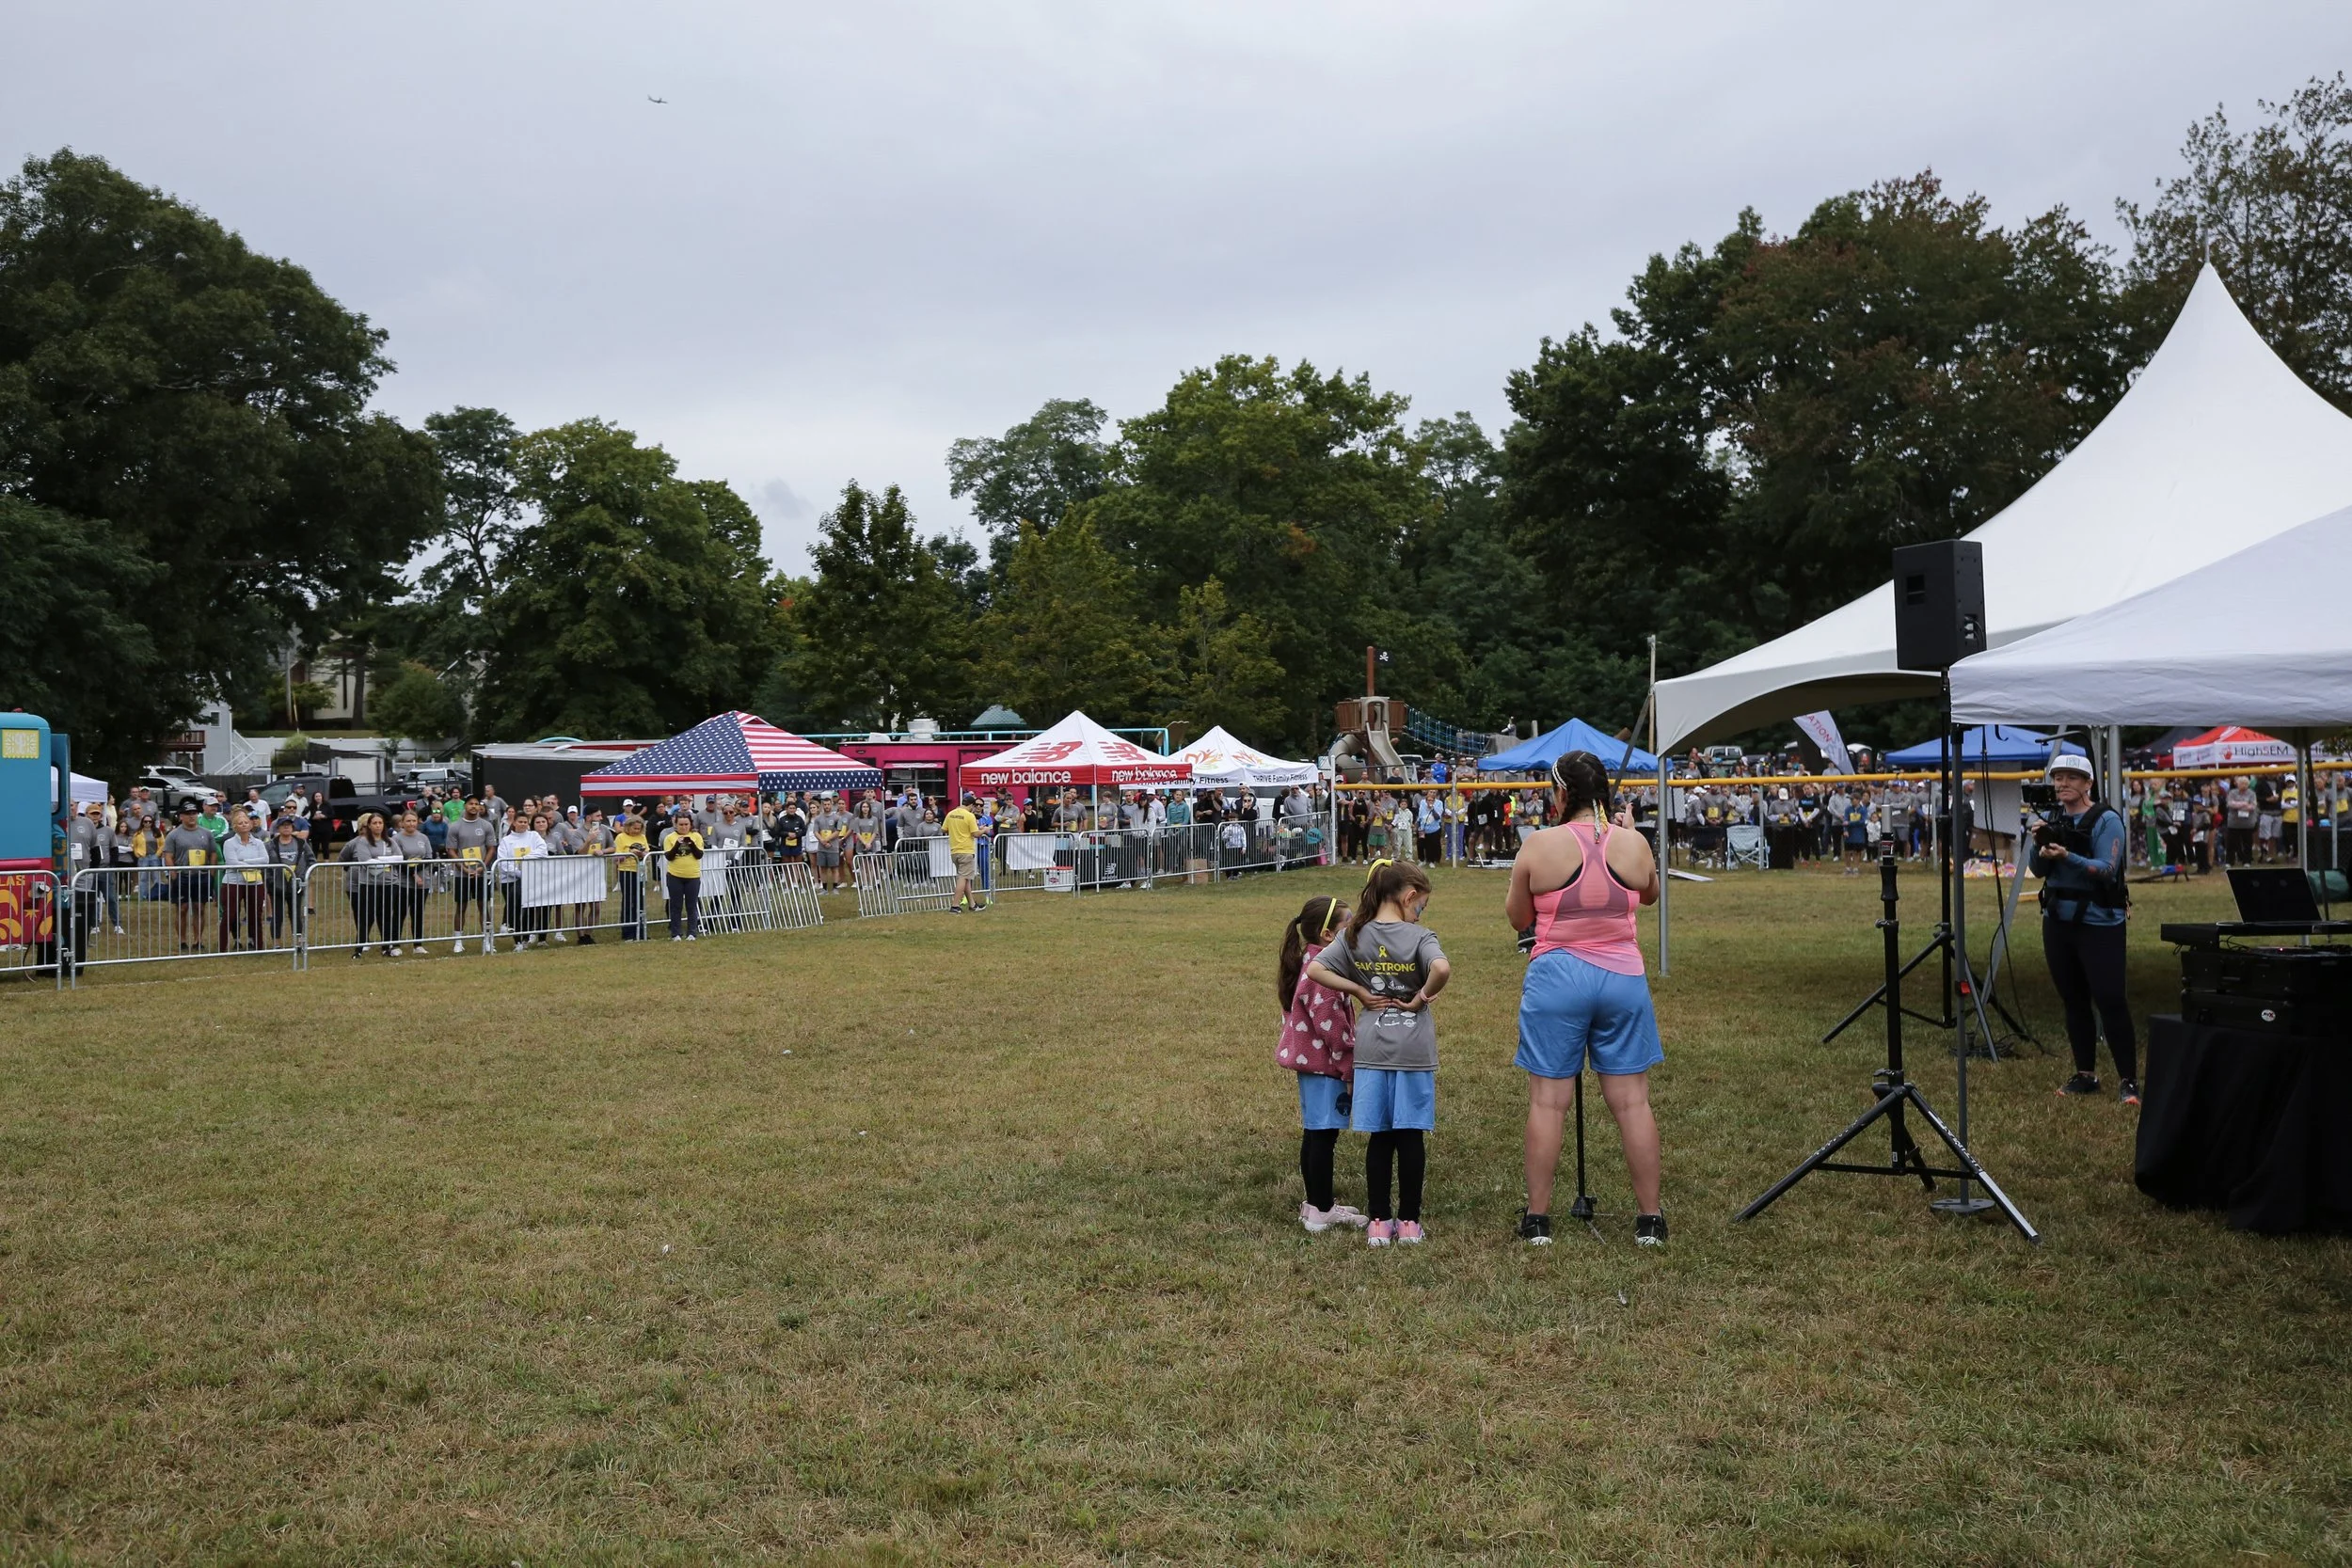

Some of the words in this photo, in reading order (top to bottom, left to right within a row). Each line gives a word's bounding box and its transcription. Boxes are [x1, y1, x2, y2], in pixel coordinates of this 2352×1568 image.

[980, 772, 1009, 784] new
[1011, 768, 1072, 784] balance
[1111, 769, 1134, 783] new
[1135, 766, 1178, 782] balance
[1199, 776, 1229, 784] Fitness
[1252, 774, 1272, 783] THRIVE
[1273, 774, 1290, 783] Family
[1375, 961, 1416, 973] STRONG
